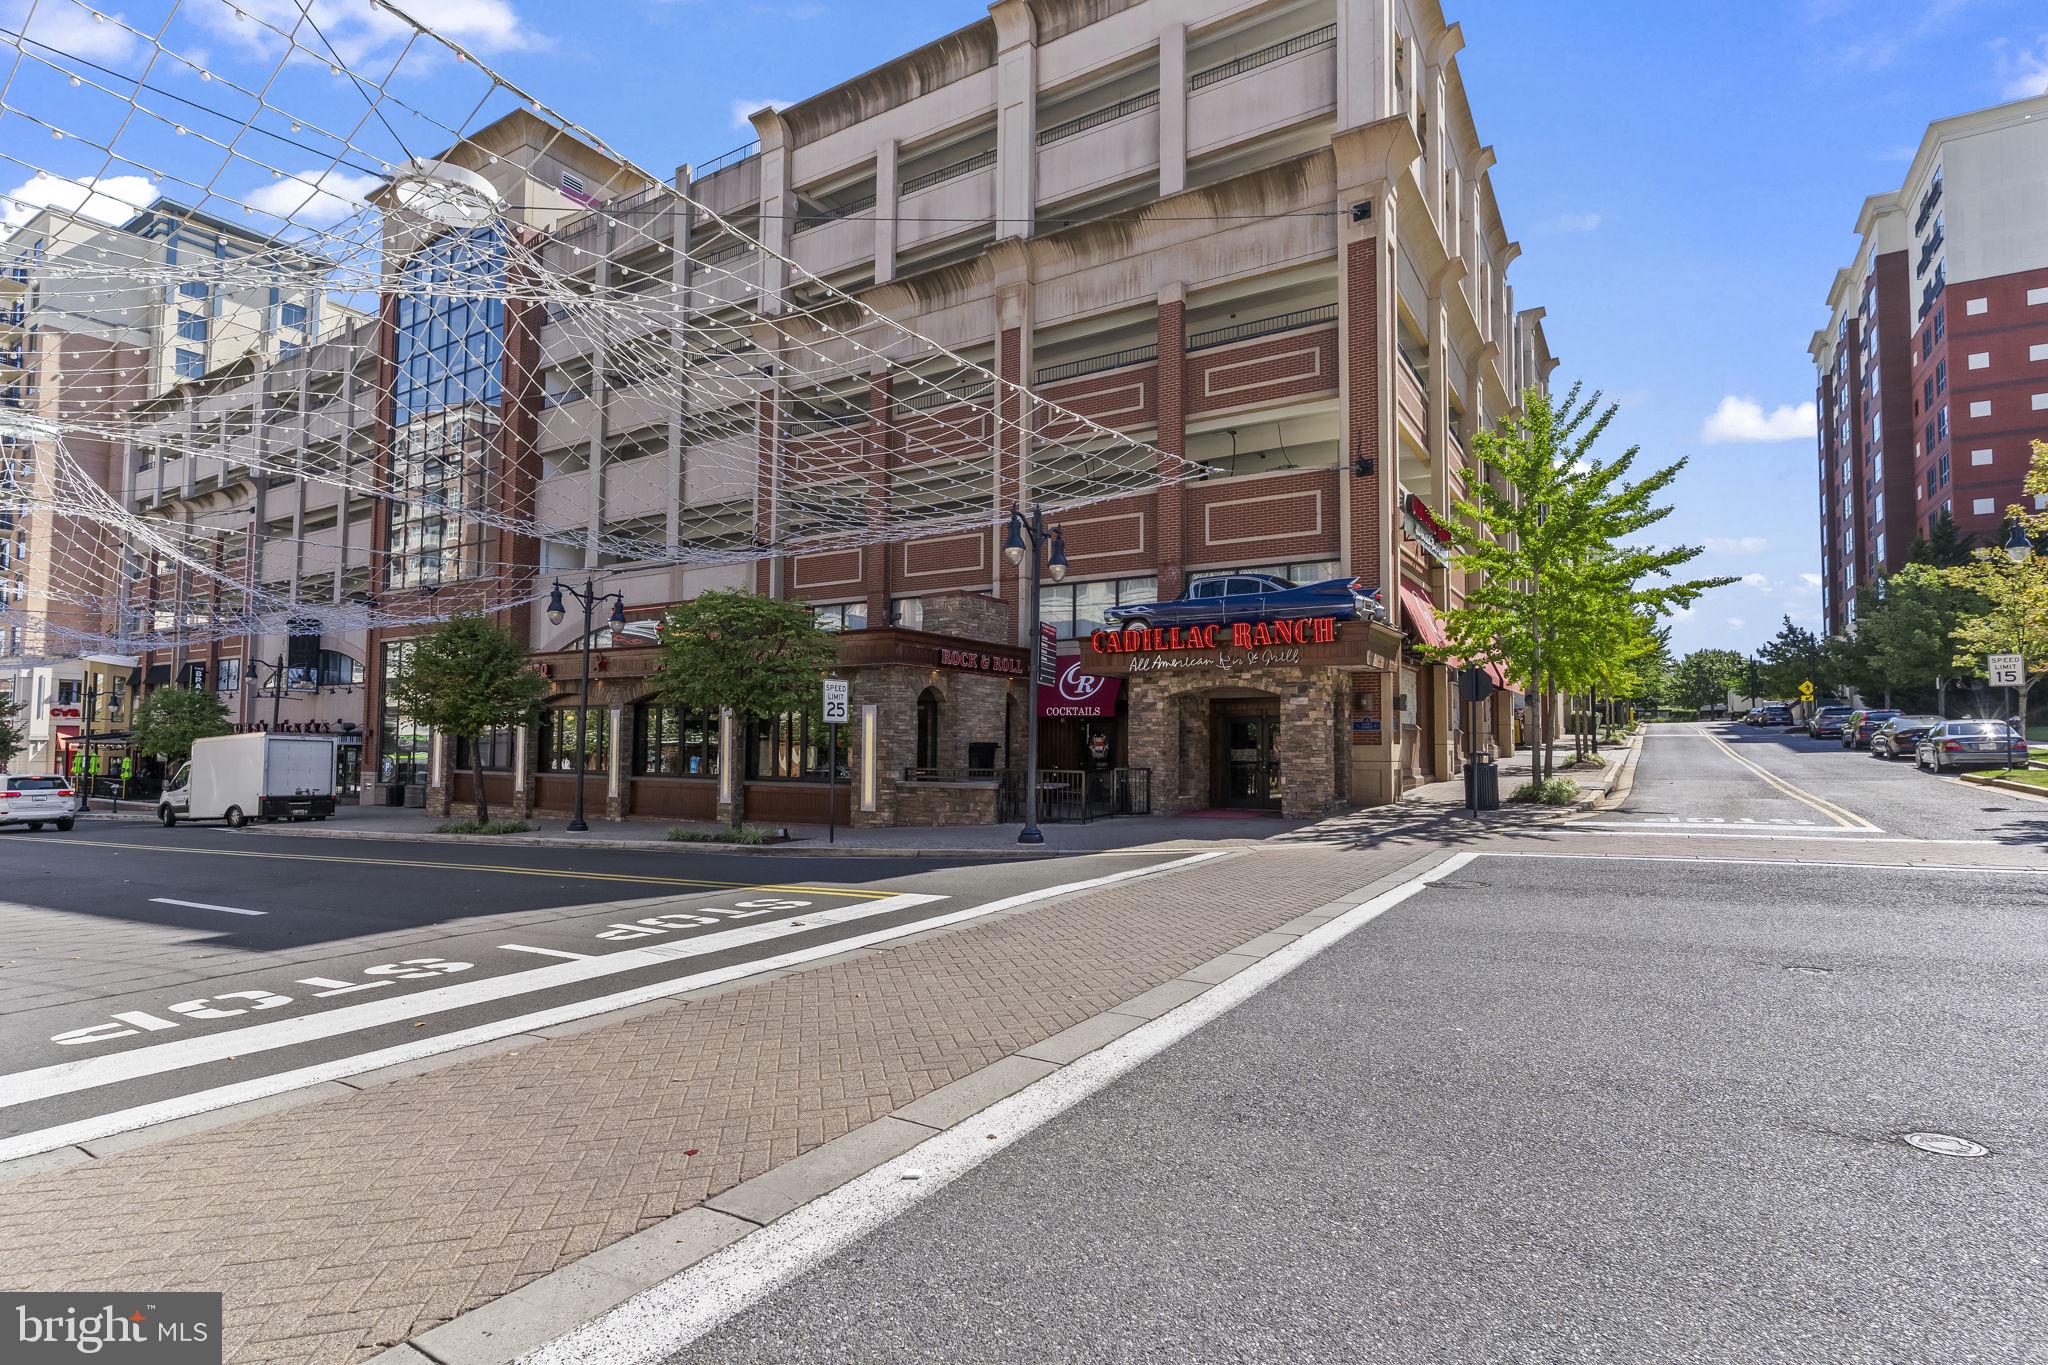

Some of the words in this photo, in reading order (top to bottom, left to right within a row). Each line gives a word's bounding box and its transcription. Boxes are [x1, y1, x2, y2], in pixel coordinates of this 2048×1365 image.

[1091, 623, 1221, 654] CADILLAC
[1232, 616, 1337, 650] RANCH
[941, 648, 978, 669] ROCK
[980, 654, 991, 670] &
[993, 656, 1024, 674] ROLL
[1129, 656, 1151, 672] All
[1151, 653, 1214, 669] American
[1261, 648, 1300, 667] Grill
[1995, 670, 2017, 683] 15
[825, 684, 847, 692] SPEED
[50, 708, 80, 717] CVS
[826, 701, 845, 718] 25
[1046, 706, 1101, 716] COCKTAILS
[595, 899, 812, 941] STOP
[50, 958, 475, 1045] STOP
